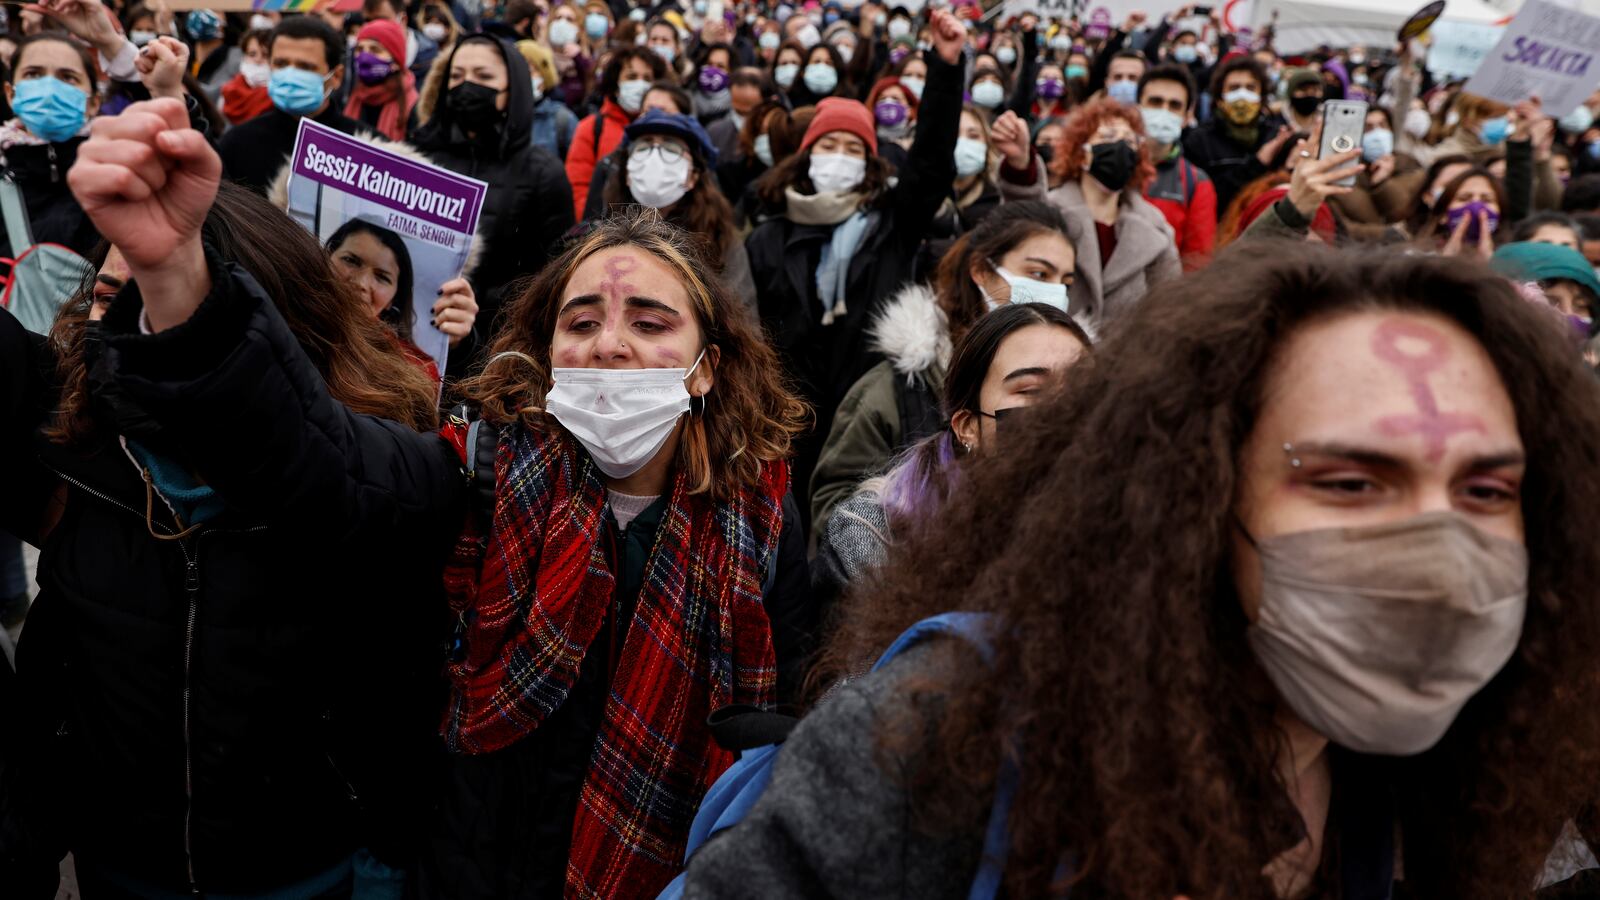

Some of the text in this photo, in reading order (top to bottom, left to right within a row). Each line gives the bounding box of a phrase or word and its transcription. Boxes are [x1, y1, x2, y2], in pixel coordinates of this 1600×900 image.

[304, 143, 467, 223] Sessiz Kalmıyoruz!
[387, 213, 418, 237] FATMA
